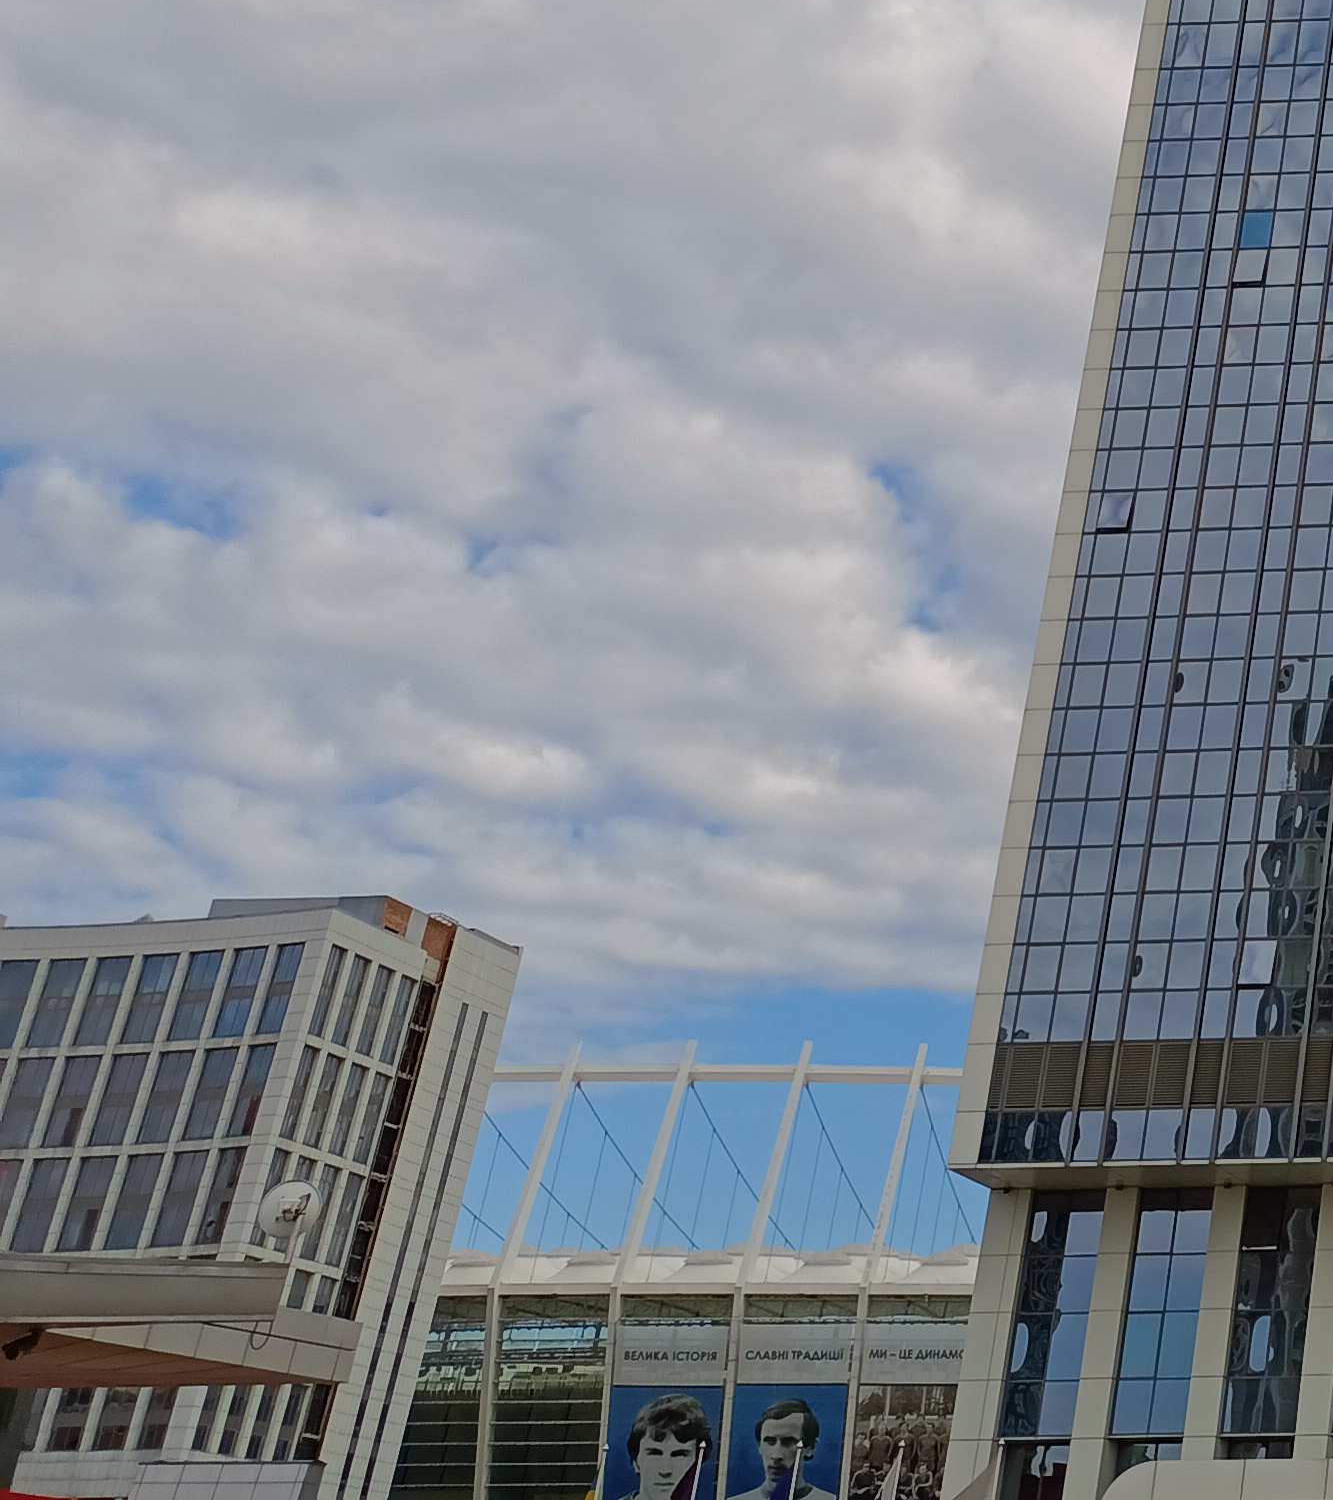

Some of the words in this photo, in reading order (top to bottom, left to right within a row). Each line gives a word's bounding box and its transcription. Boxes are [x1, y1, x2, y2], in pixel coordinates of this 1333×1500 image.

[623, 1350, 669, 1361] ВЕЛИКА
[672, 1350, 718, 1361] ІСТОРІЯ
[745, 1350, 788, 1361] СЛАВНІ
[791, 1348, 844, 1361] ТРАДИЦІЇ
[868, 1349, 887, 1359] МИ
[899, 1349, 914, 1360] ЦЕ
